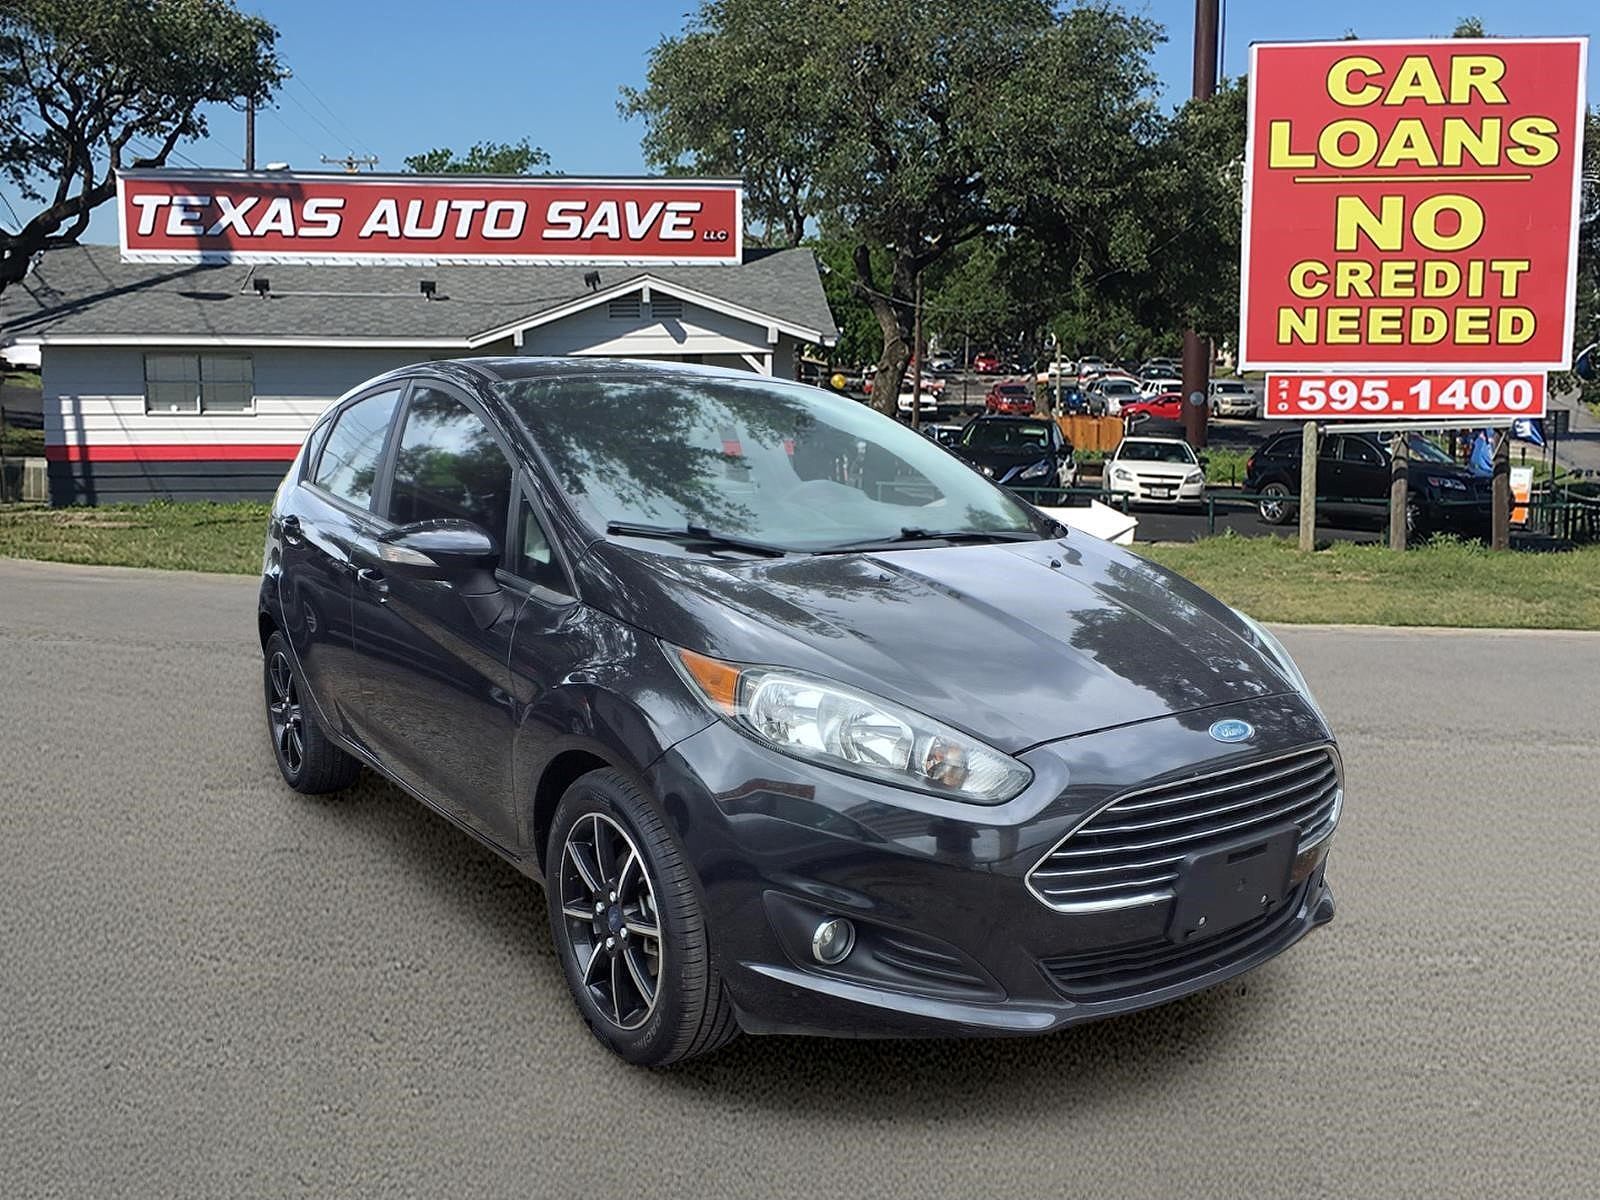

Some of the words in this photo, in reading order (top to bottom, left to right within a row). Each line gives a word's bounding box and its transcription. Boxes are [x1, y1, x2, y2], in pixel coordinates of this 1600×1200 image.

[1326, 54, 1510, 106] CAR
[1268, 116, 1560, 168] LOANS
[132, 195, 345, 237] TEXAS
[358, 198, 527, 240] AUTO
[542, 200, 702, 241] SAVE
[703, 230, 728, 241] LLC
[1334, 194, 1485, 251] NO
[1288, 259, 1531, 298] CREDIT
[1277, 306, 1537, 345] NEEDED
[1297, 378, 1533, 411] 595.1400
